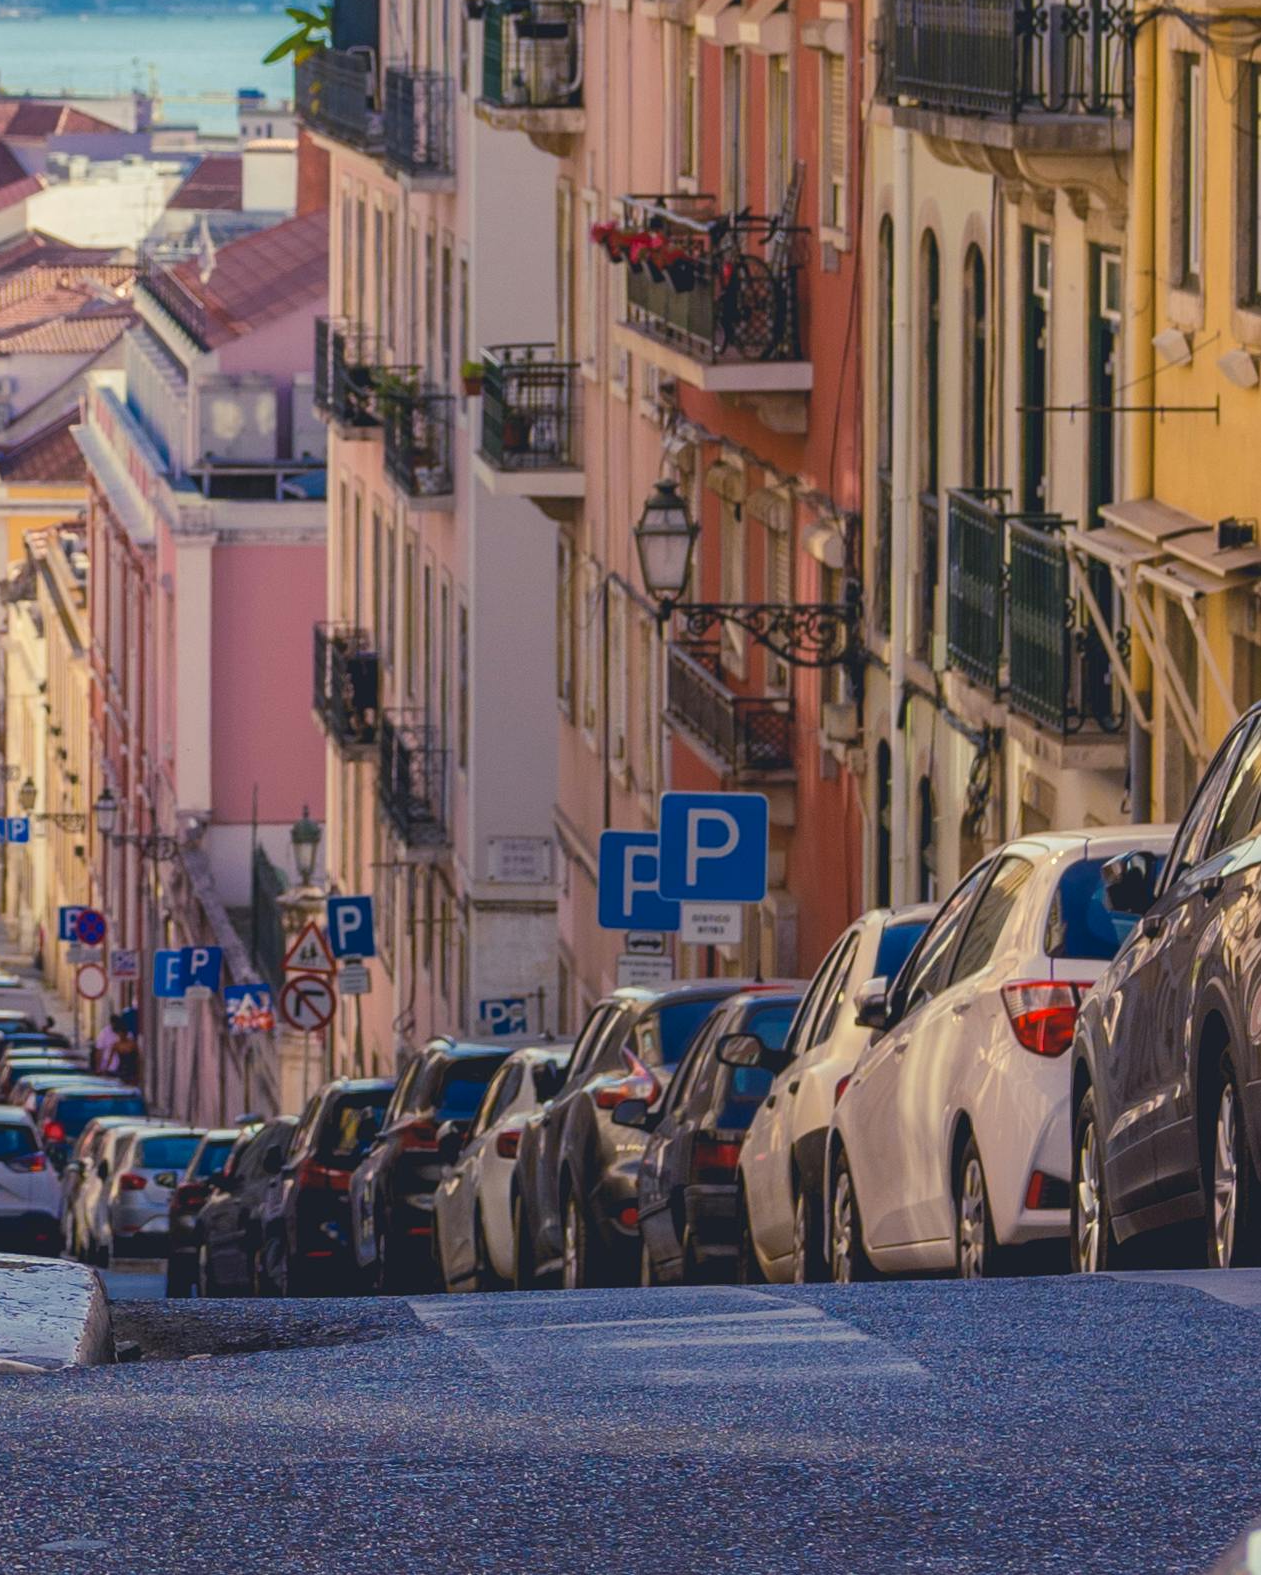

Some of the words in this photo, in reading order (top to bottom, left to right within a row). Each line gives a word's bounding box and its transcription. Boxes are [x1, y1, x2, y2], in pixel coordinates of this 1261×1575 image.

[11, 819, 26, 840] P
[686, 808, 740, 886] P
[337, 905, 362, 950] P
[190, 949, 209, 975] P
